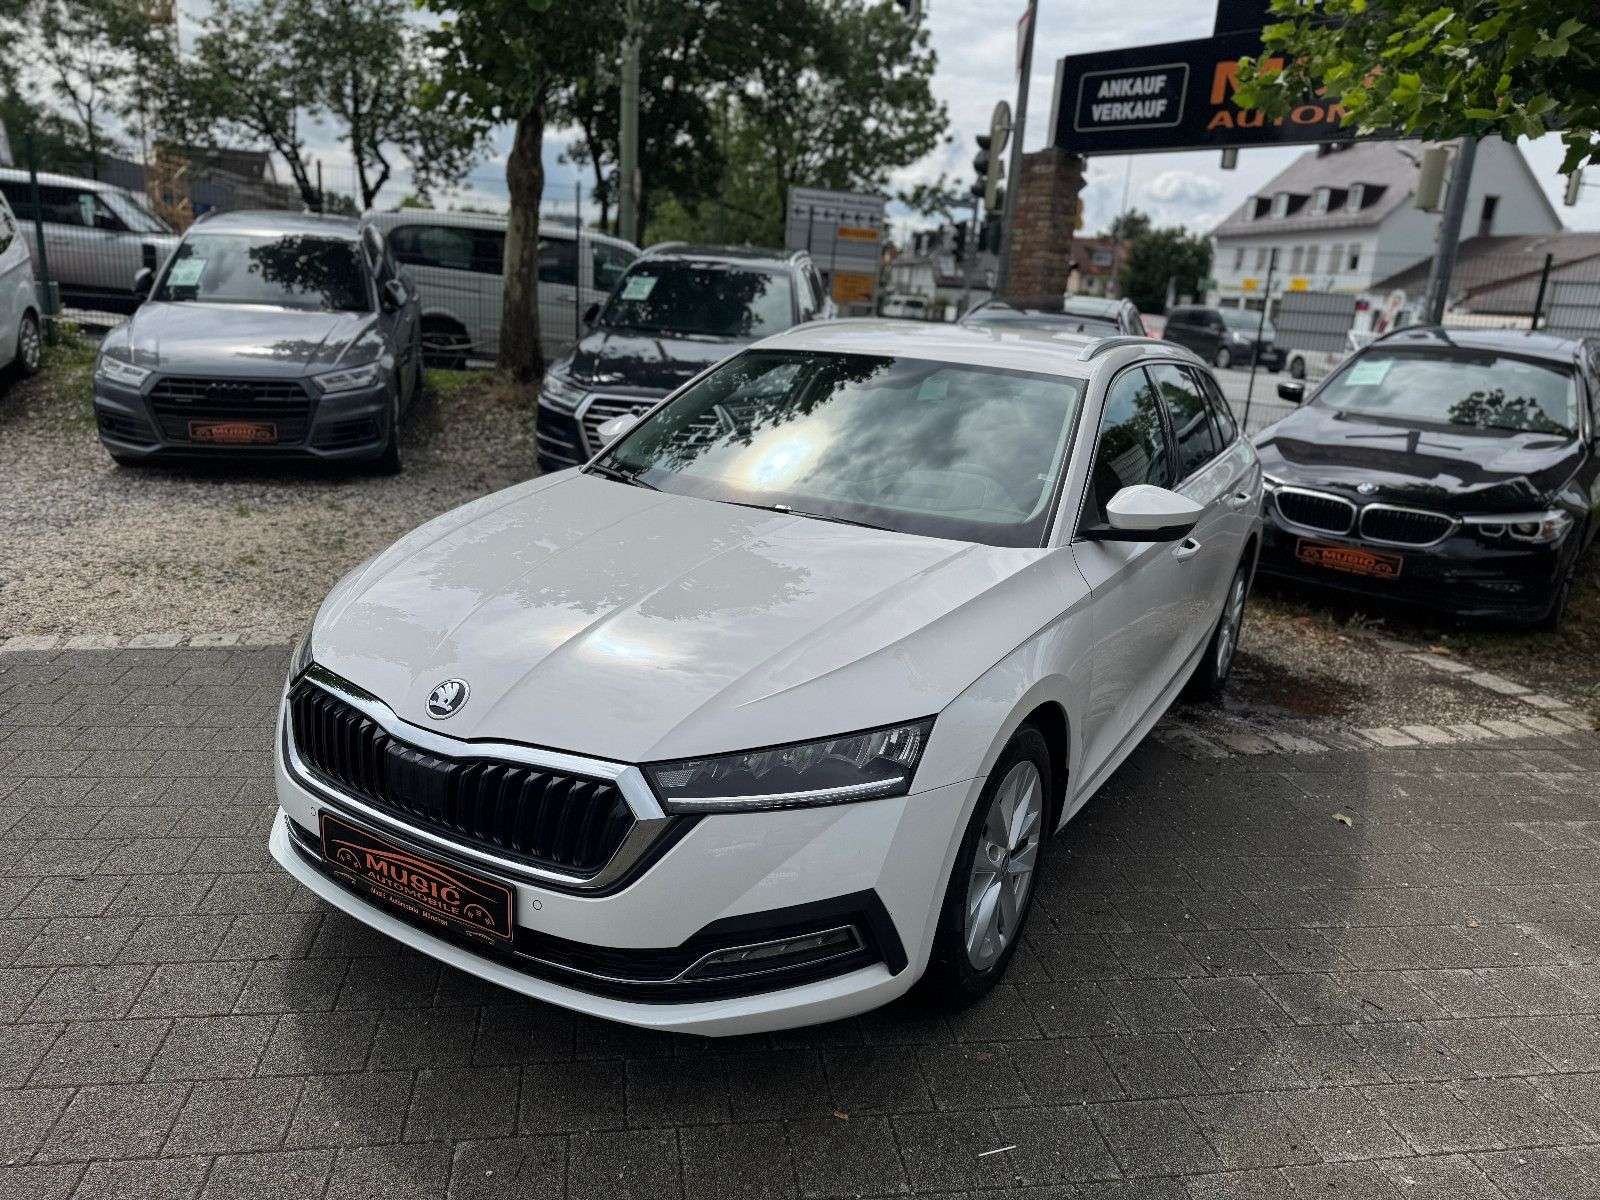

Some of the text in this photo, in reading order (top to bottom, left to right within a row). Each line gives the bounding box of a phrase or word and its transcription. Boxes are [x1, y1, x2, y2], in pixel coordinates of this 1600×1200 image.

[1097, 75, 1167, 98] ANKAUF
[1092, 99, 1167, 122] VERKAUF
[368, 871, 460, 915] AUTOMOBILE
